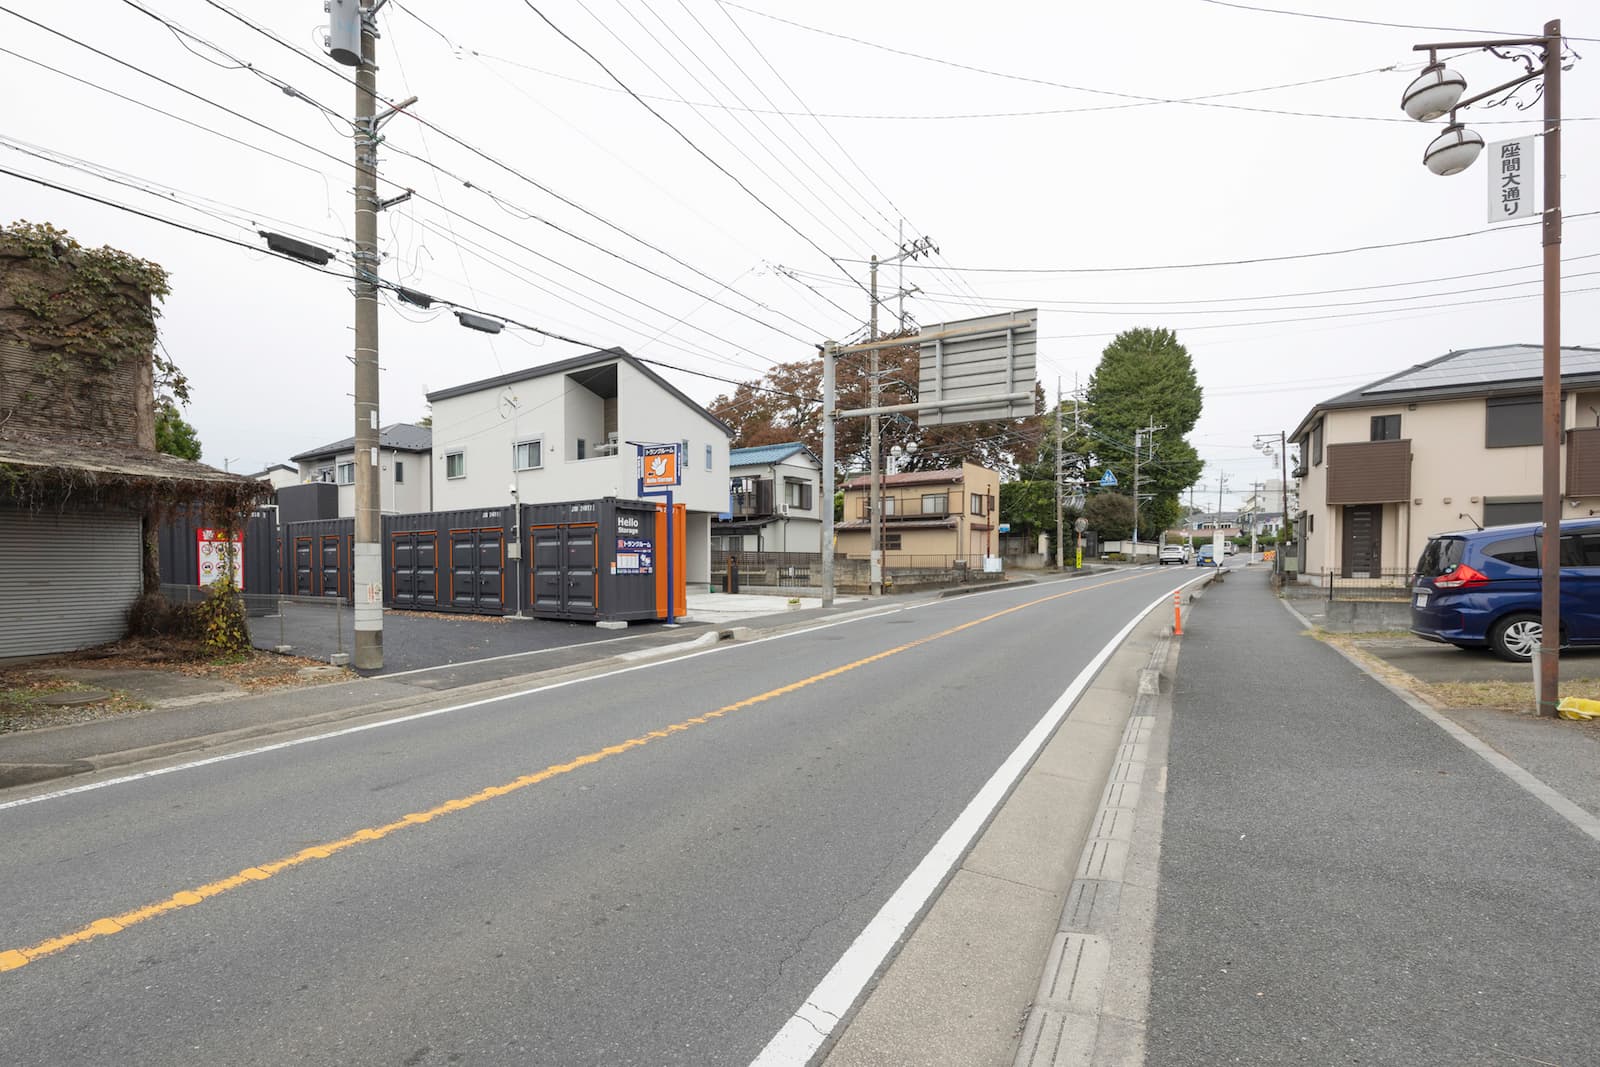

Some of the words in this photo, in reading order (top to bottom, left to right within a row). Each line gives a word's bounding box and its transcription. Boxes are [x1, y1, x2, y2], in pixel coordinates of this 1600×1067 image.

[1501, 142, 1521, 216] 座間大通り
[617, 517, 638, 527] Hello
[618, 527, 638, 535] Storage
